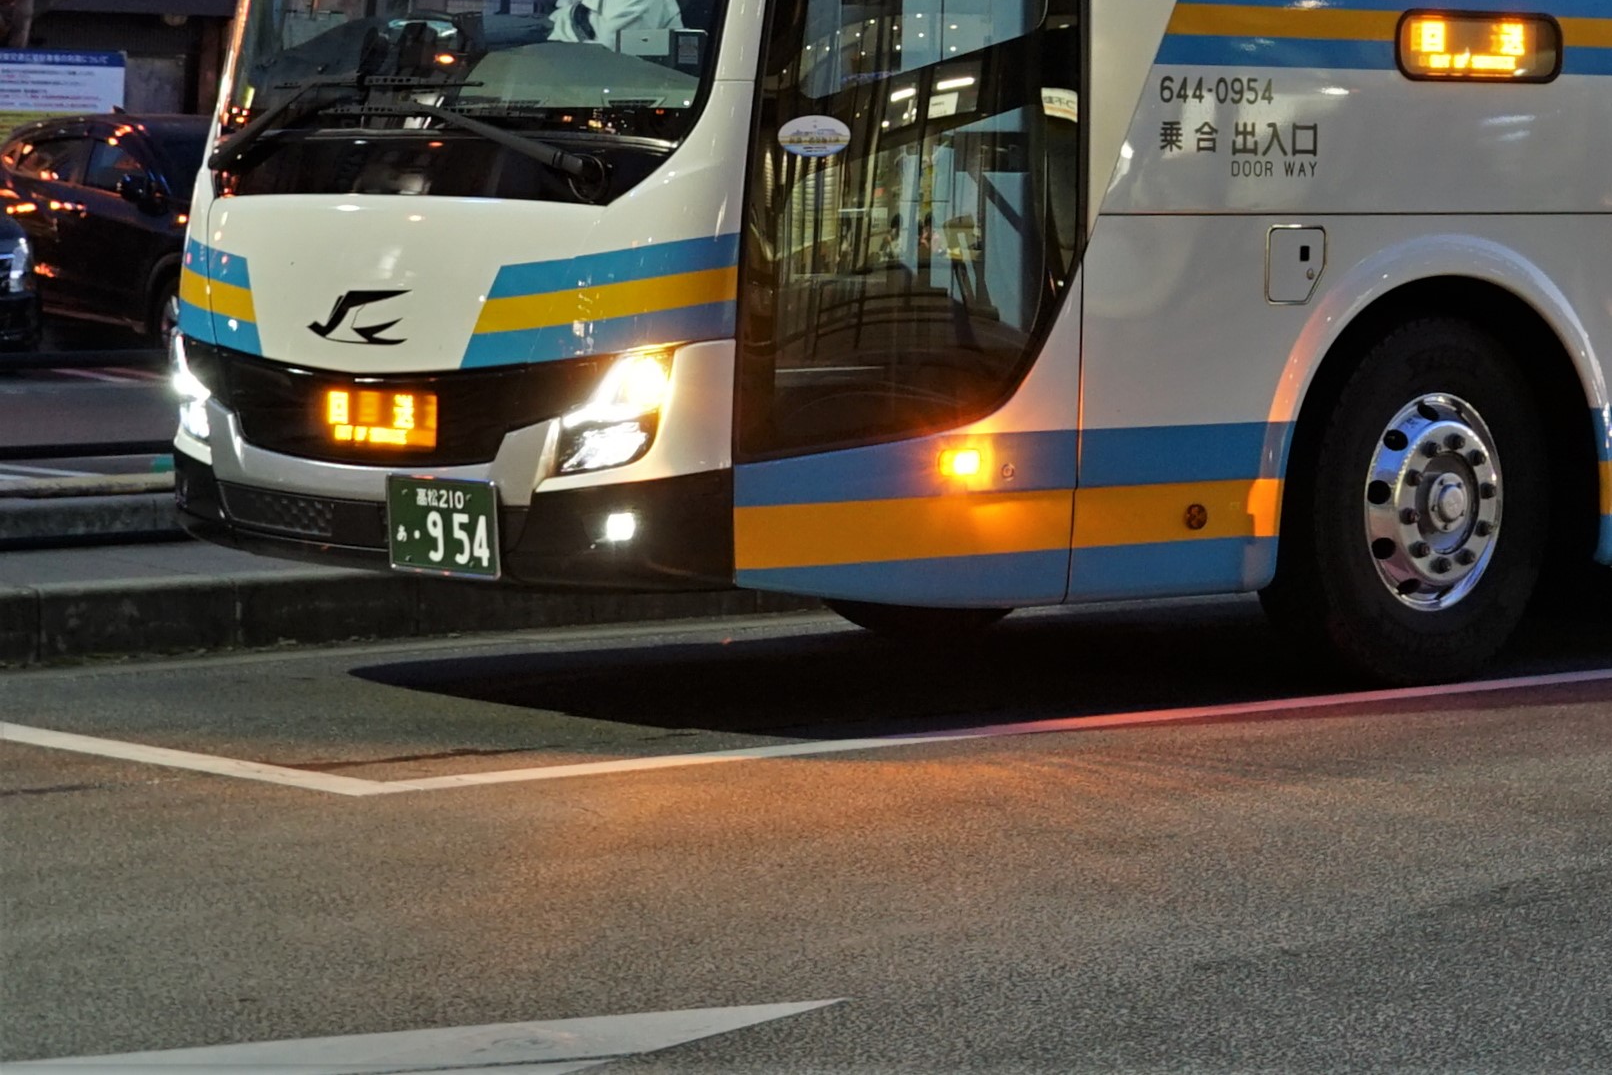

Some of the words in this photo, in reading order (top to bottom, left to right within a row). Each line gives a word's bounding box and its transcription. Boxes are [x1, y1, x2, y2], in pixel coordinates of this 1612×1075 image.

[1159, 75, 1275, 105] 644-0954
[1231, 121, 1318, 157] 出入口
[1231, 160, 1274, 177] DOOR
[1284, 161, 1318, 177] WAY
